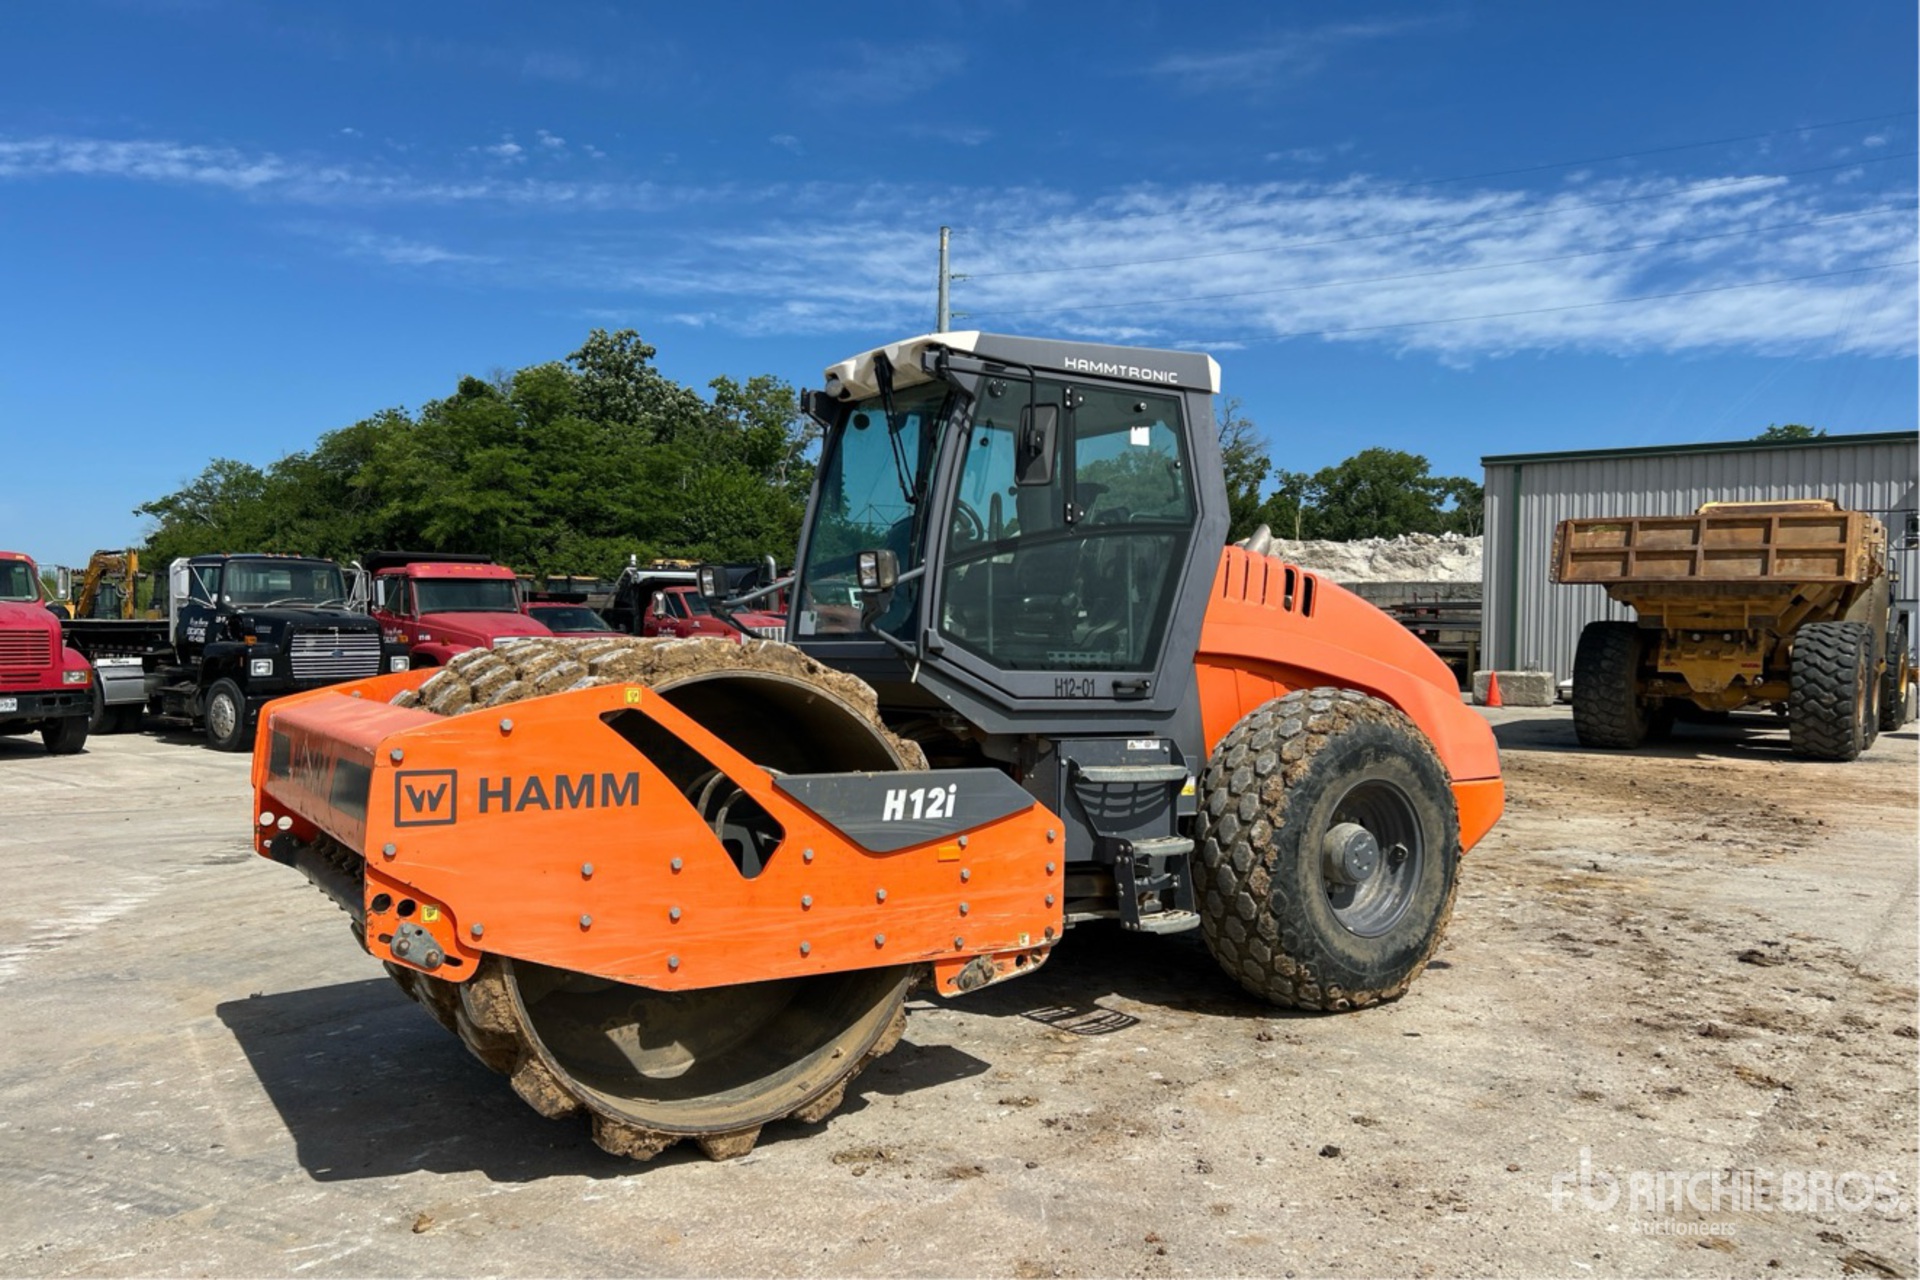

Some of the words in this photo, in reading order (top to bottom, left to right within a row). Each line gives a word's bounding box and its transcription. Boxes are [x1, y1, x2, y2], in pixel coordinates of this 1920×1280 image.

[1064, 357, 1178, 384] HAMMTRONIC
[1054, 677, 1095, 698] H12-01
[478, 772, 640, 813] HAMM
[882, 783, 957, 822] H12i
